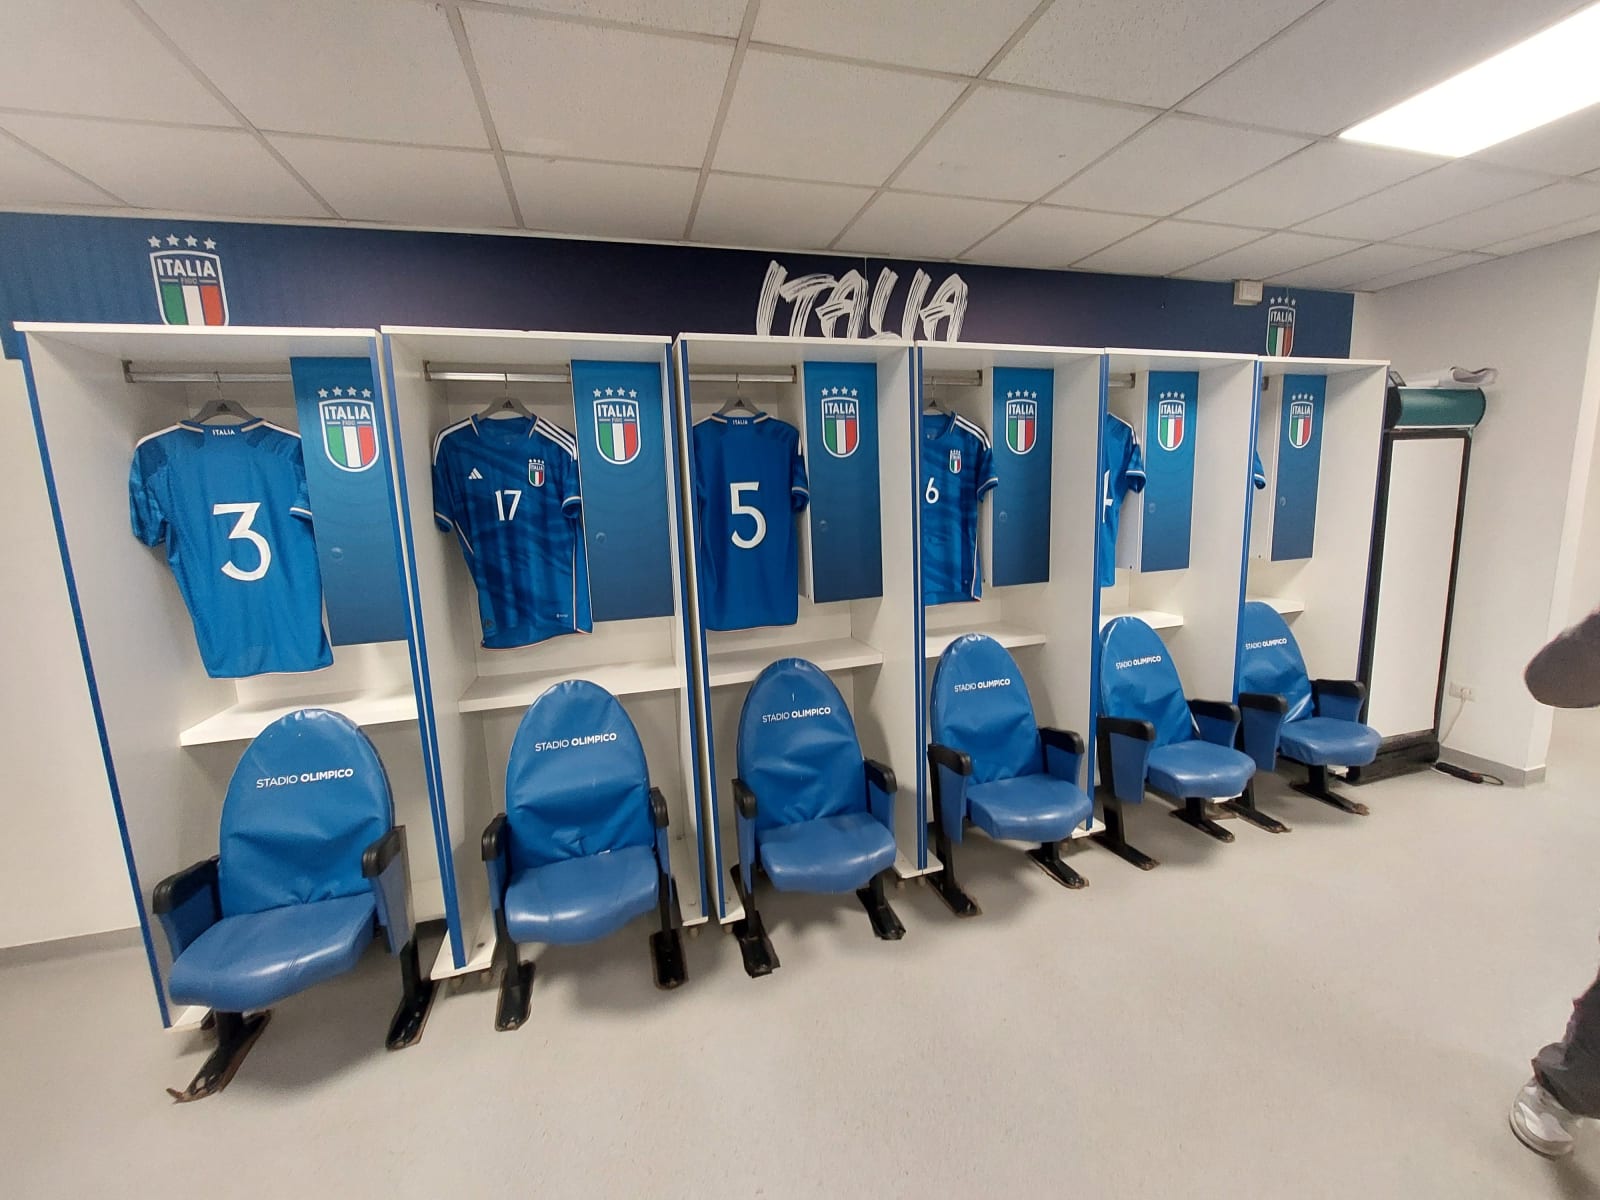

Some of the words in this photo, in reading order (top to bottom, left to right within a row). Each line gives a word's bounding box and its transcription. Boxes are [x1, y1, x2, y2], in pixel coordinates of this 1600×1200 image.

[157, 258, 217, 277] ITALIA
[756, 259, 969, 343] ITALIA
[1270, 310, 1293, 323] ITALIA
[324, 405, 371, 420] ITALIA
[597, 404, 635, 417] ITALIA
[825, 402, 855, 415] ITALIA
[1008, 403, 1034, 416] ITALIA
[1160, 404, 1183, 415] ITALIA
[1292, 405, 1311, 415] ITALIA
[925, 477, 939, 504] 6
[495, 489, 522, 521] 17
[730, 481, 767, 549] 5
[213, 502, 271, 581] 3
[1132, 655, 1162, 666] OLIMPICO
[954, 682, 977, 693] STADIO
[977, 678, 1011, 689] OLIMPICO
[762, 711, 790, 723] STADIO
[791, 706, 831, 719] OLIMPICO
[535, 739, 570, 752] STADIO
[571, 732, 617, 746] OLIMPICO
[256, 775, 298, 789] STADIO
[300, 768, 354, 783] OLIMPICO
